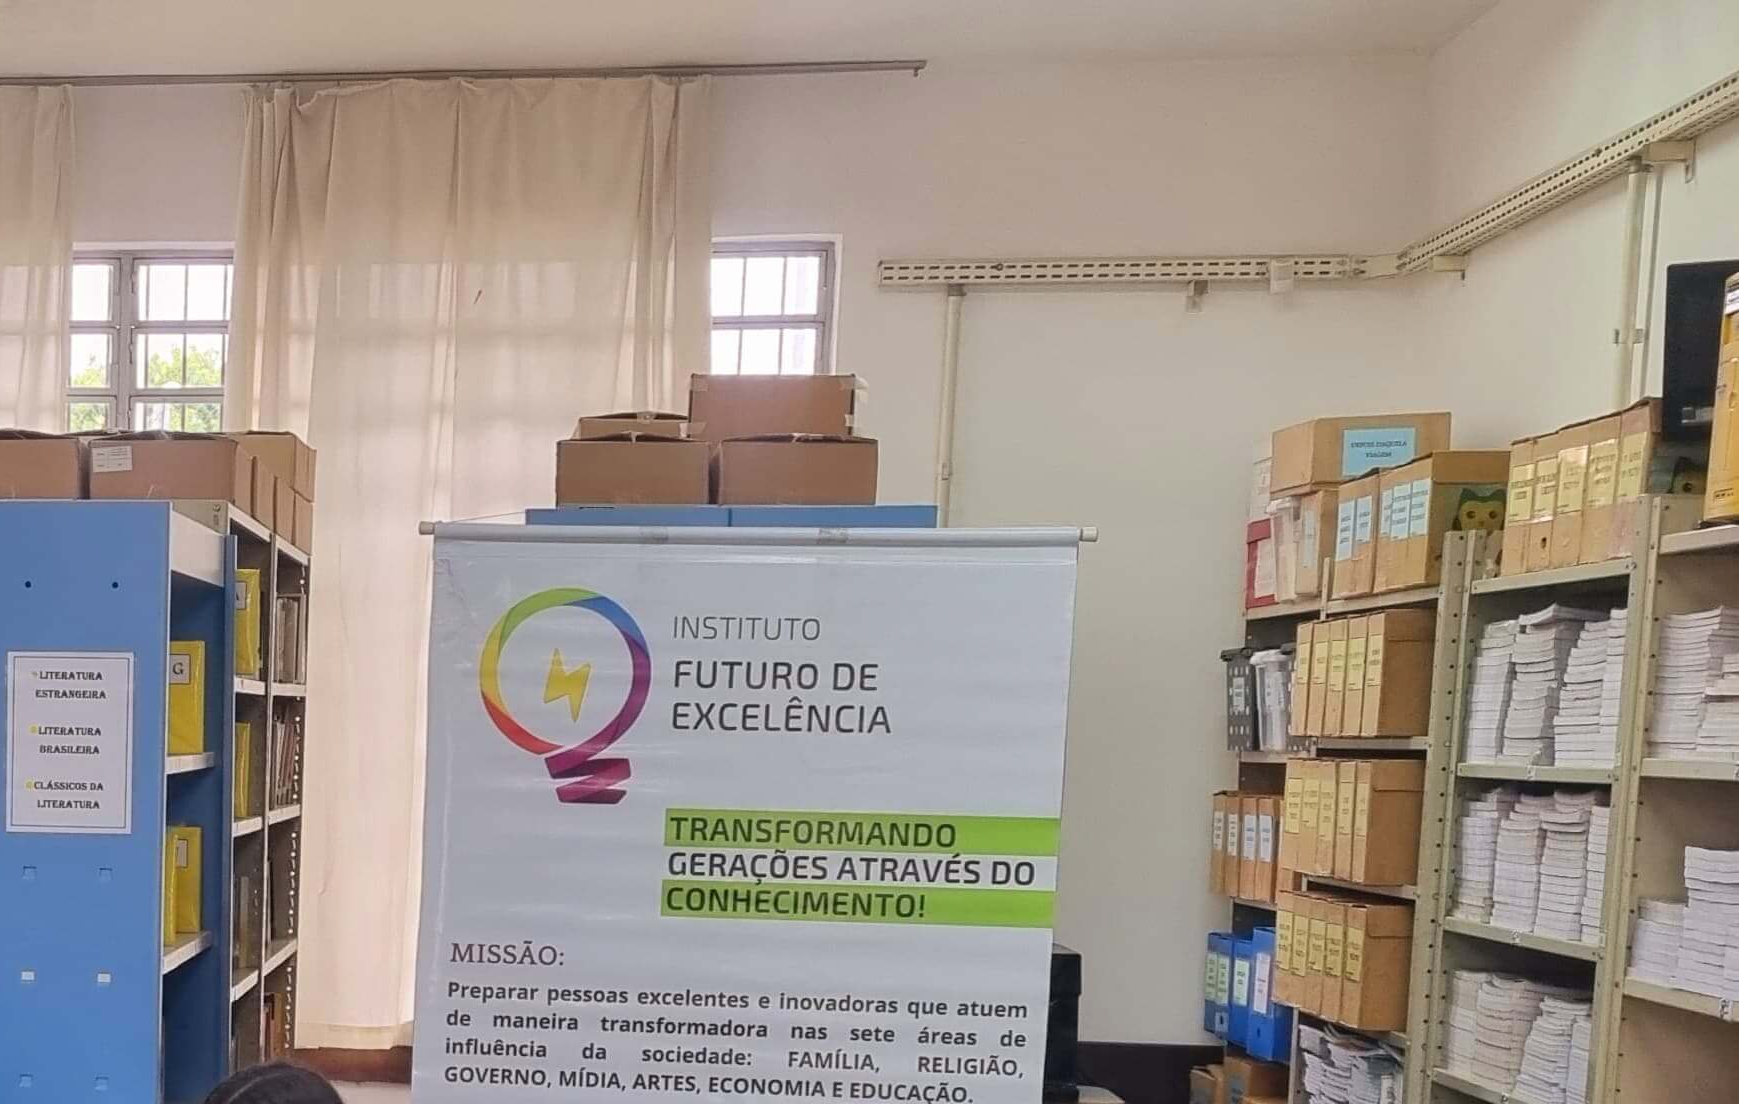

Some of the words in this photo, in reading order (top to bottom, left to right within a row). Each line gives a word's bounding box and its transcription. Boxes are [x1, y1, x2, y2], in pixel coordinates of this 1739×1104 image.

[673, 615, 821, 641] INSTITUTO
[39, 671, 103, 681] LITERATURA
[172, 662, 184, 675] G
[674, 660, 819, 690] FUTURO
[832, 662, 879, 692] DE
[35, 689, 107, 700] ESTRANGEIRA
[672, 697, 891, 734] EXCELÊNCIA
[38, 726, 102, 737] LITERATURA
[39, 744, 100, 755] BRASILEIRA
[33, 779, 88, 791] CLÁSSICOS
[89, 782, 104, 791] DA
[36, 799, 100, 810] LITERATURA
[669, 816, 956, 848] TRANSFORMANDO
[668, 849, 828, 886] GERAÇÕES
[836, 856, 981, 885] ATRAVÉS
[991, 860, 1035, 886] DO
[666, 886, 926, 918] CONHECIMENTO!
[449, 940, 565, 966] MISSÃO:
[448, 981, 539, 1004] Preparar
[547, 985, 629, 1008] pessoas
[637, 988, 750, 1009] excelentes
[758, 995, 771, 1009] e
[779, 992, 898, 1014] inovadoras
[907, 1001, 948, 1020] que
[956, 1001, 1027, 1019] atuem
[446, 1009, 471, 1027] de
[493, 1012, 578, 1031] maneira
[600, 1016, 768, 1038] transformadora
[790, 1026, 828, 1040] nas
[849, 1026, 895, 1043] sete
[917, 1026, 977, 1046] áreas
[1000, 1029, 1027, 1048] de
[445, 1037, 547, 1058] influência
[581, 1042, 607, 1060] da
[641, 1045, 752, 1066] sociedade:
[788, 1048, 880, 1074] FAMÍLIA,
[917, 1054, 1023, 1079] RELIGIÃO,
[444, 1066, 552, 1089] GOVERNO,
[559, 1066, 626, 1092] MÍDIA,
[632, 1073, 701, 1095] ARTES,
[708, 1076, 826, 1097] ECONOMIA
[832, 1081, 844, 1098] E
